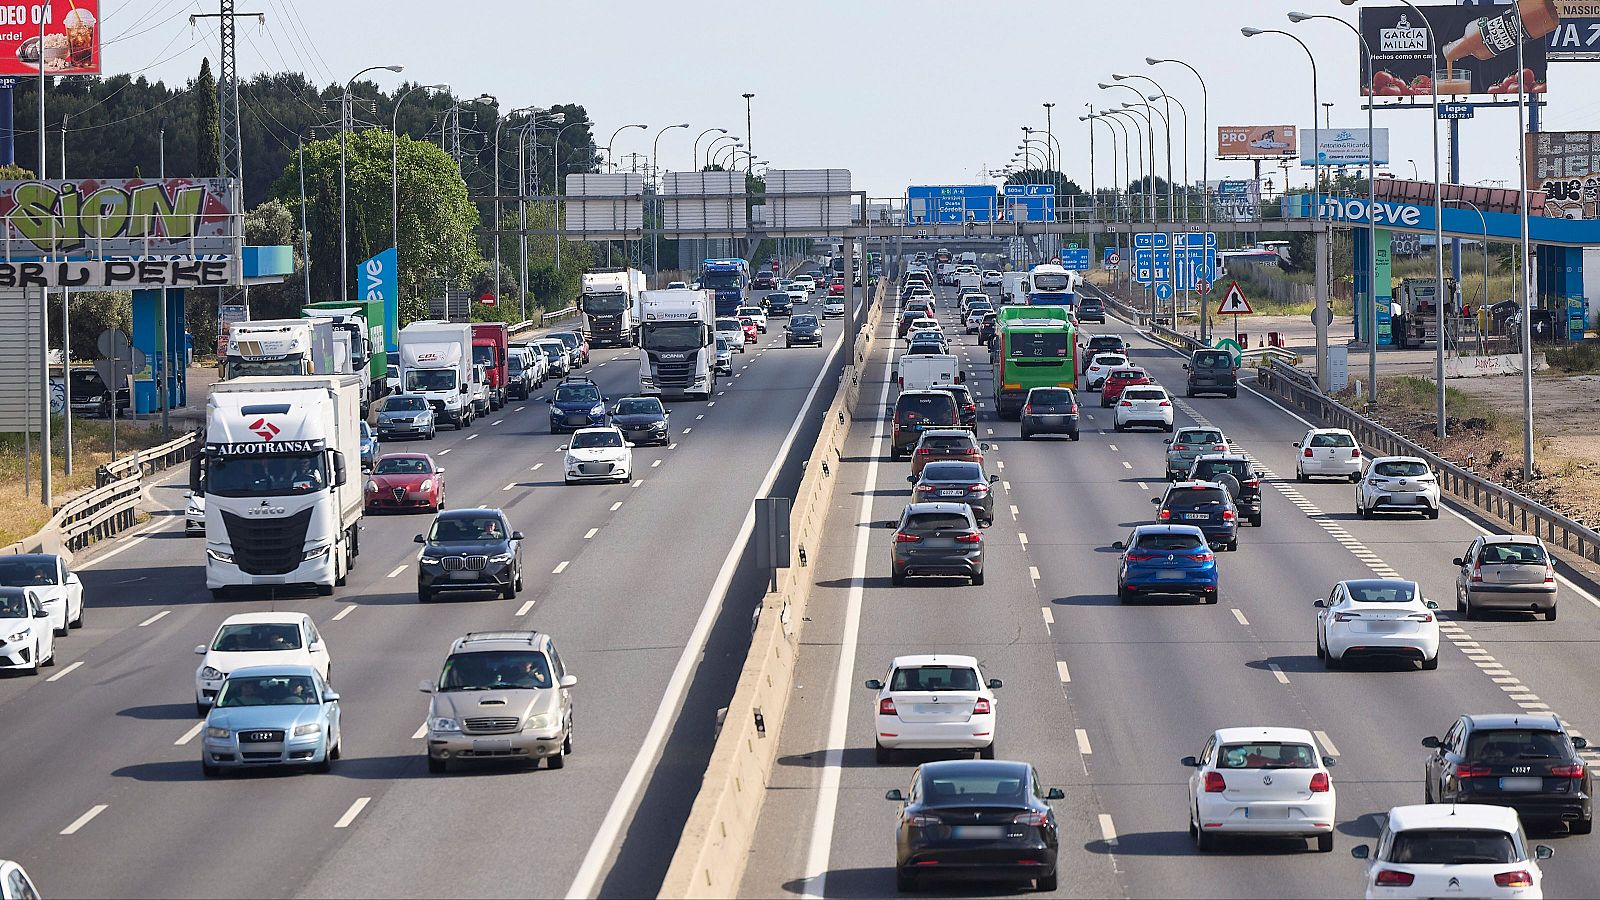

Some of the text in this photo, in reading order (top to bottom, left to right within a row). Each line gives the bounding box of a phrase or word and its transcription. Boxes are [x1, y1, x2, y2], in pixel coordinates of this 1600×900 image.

[1384, 30, 1423, 39] GARCÍA
[1384, 39, 1424, 48] MILLÁN
[1222, 133, 1247, 142] PRO
[218, 440, 313, 456] ALCOTRANSA
